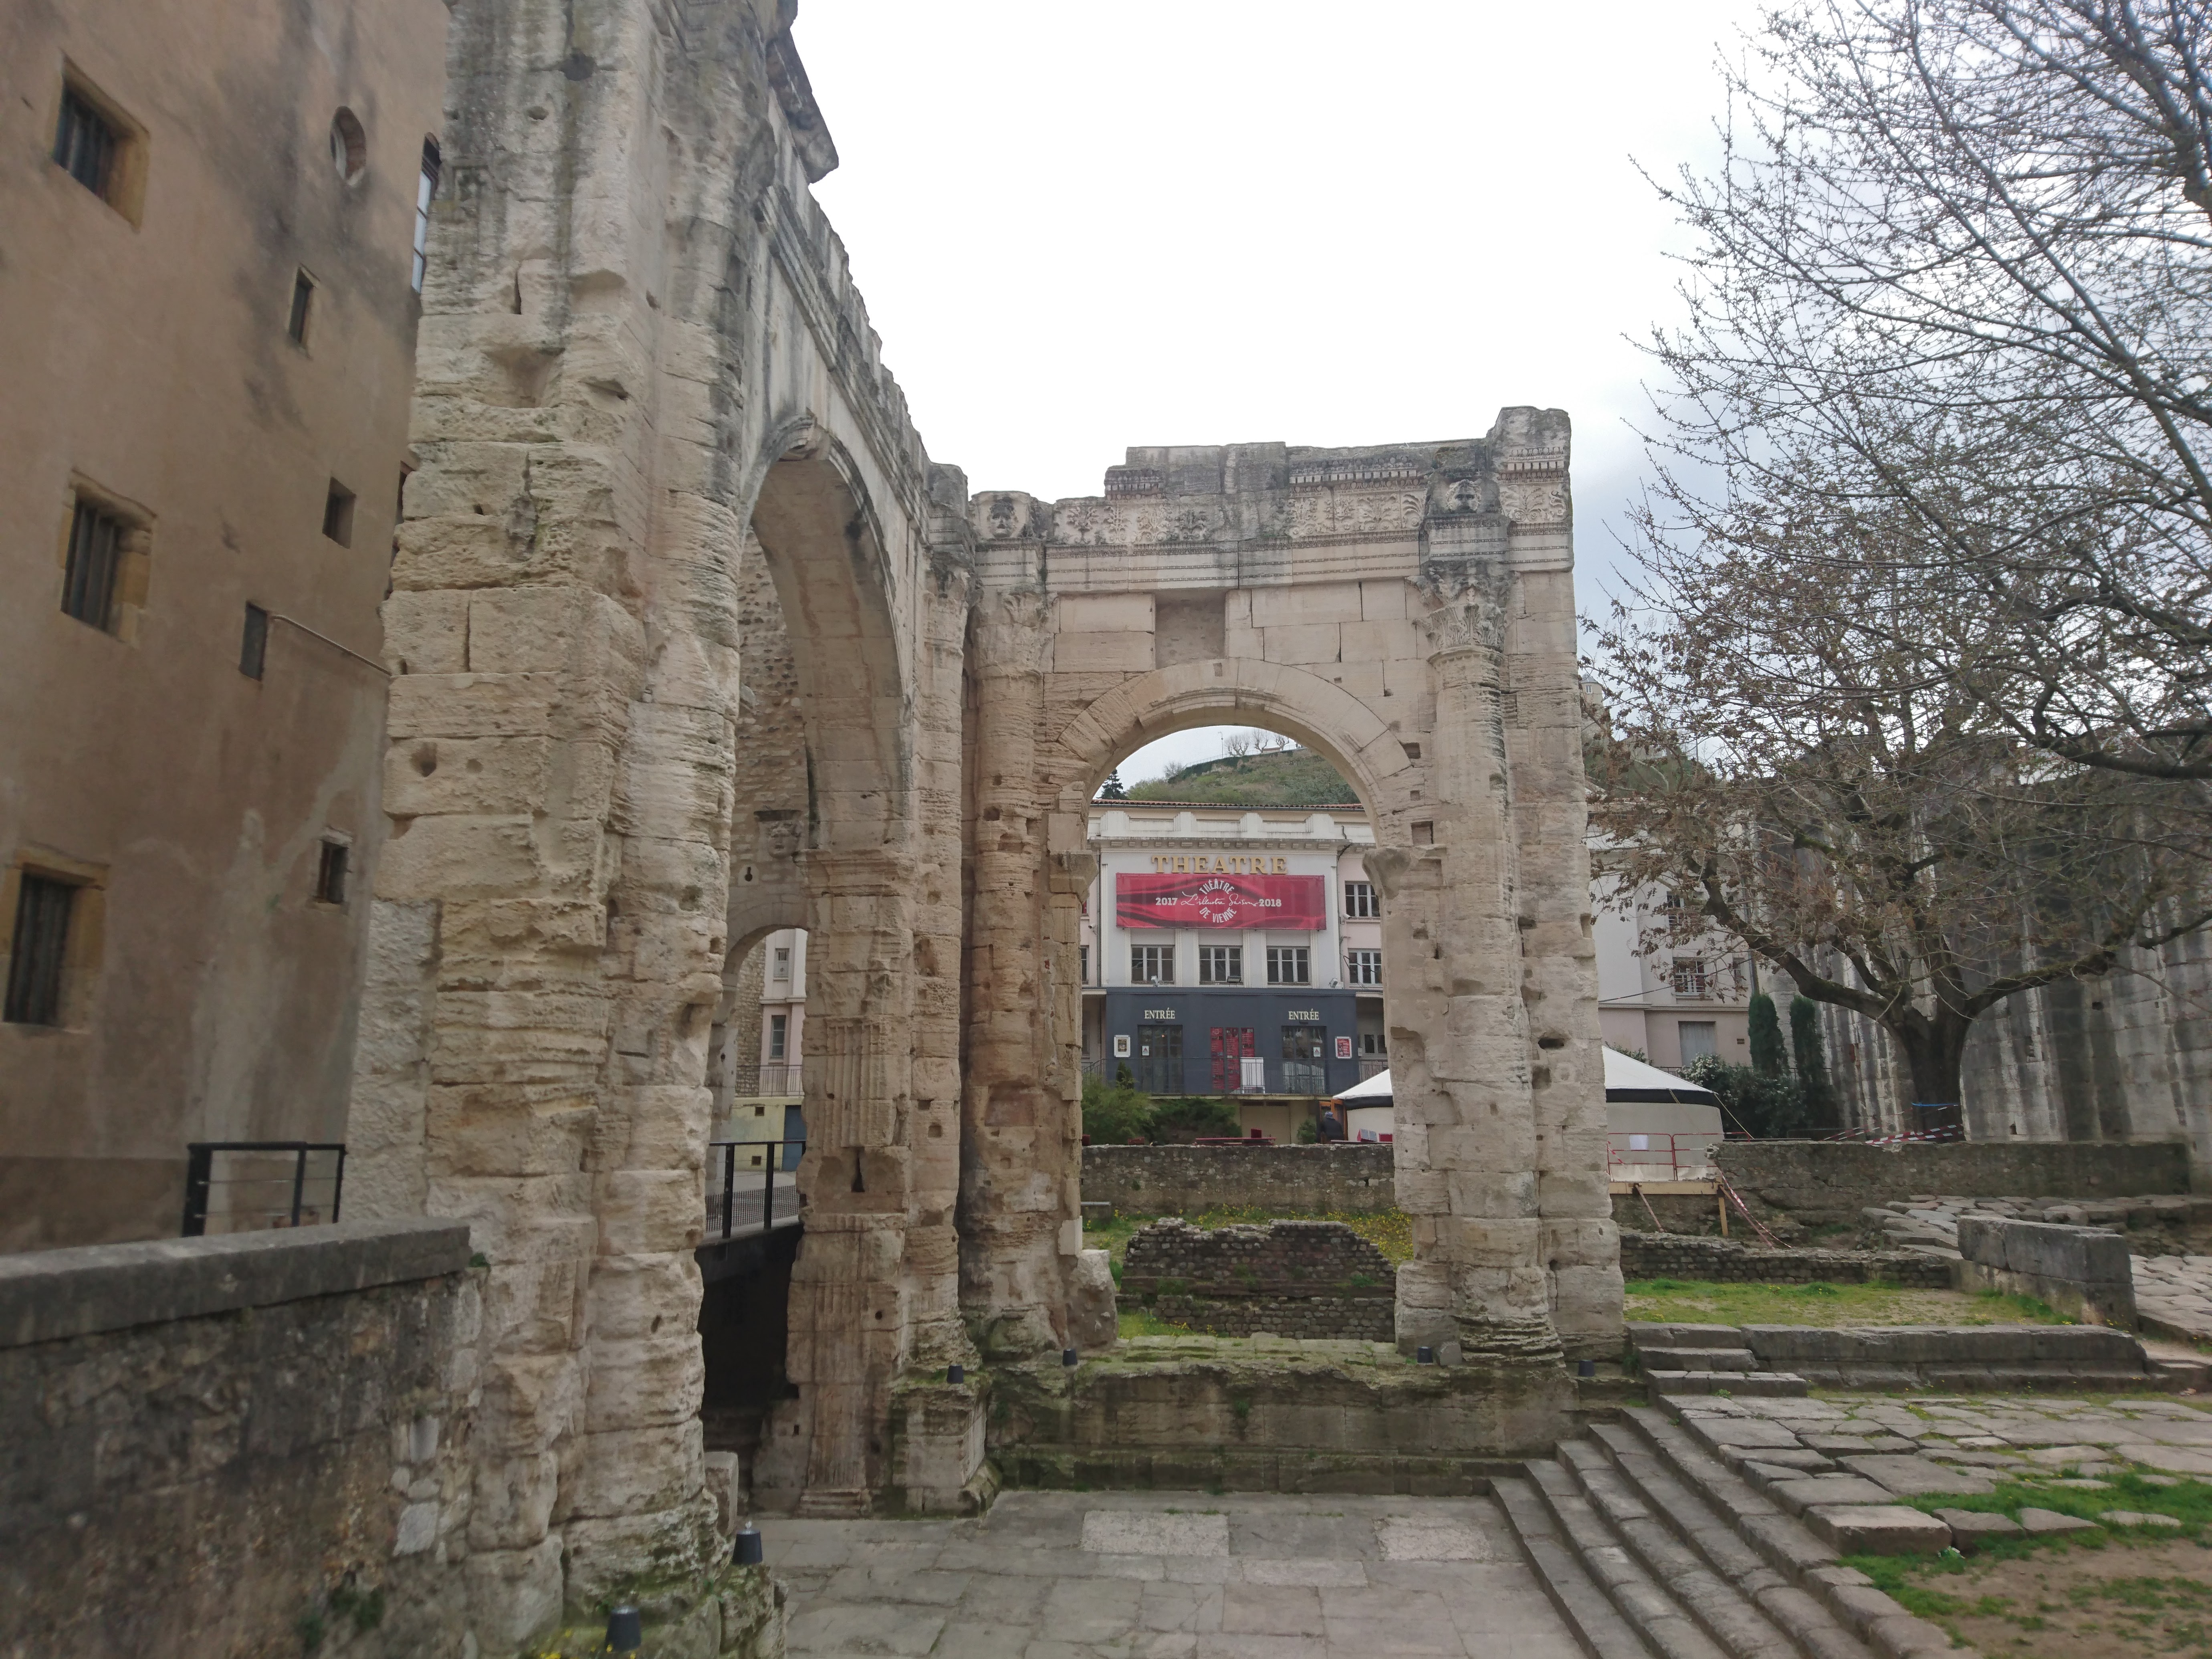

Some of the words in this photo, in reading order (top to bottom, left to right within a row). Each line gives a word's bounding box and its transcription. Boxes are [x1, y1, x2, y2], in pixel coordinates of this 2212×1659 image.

[1152, 855, 1288, 874] THEATRE
[1199, 878, 1234, 894] THÉÂTRE
[1156, 897, 1177, 905] 2017
[1259, 899, 1282, 907] 2018
[1199, 907, 1211, 919] DE
[1213, 907, 1237, 923] VIENNE
[1144, 1007, 1175, 1019] ENTRÉE
[1288, 1008, 1319, 1020] ENTRÉE
